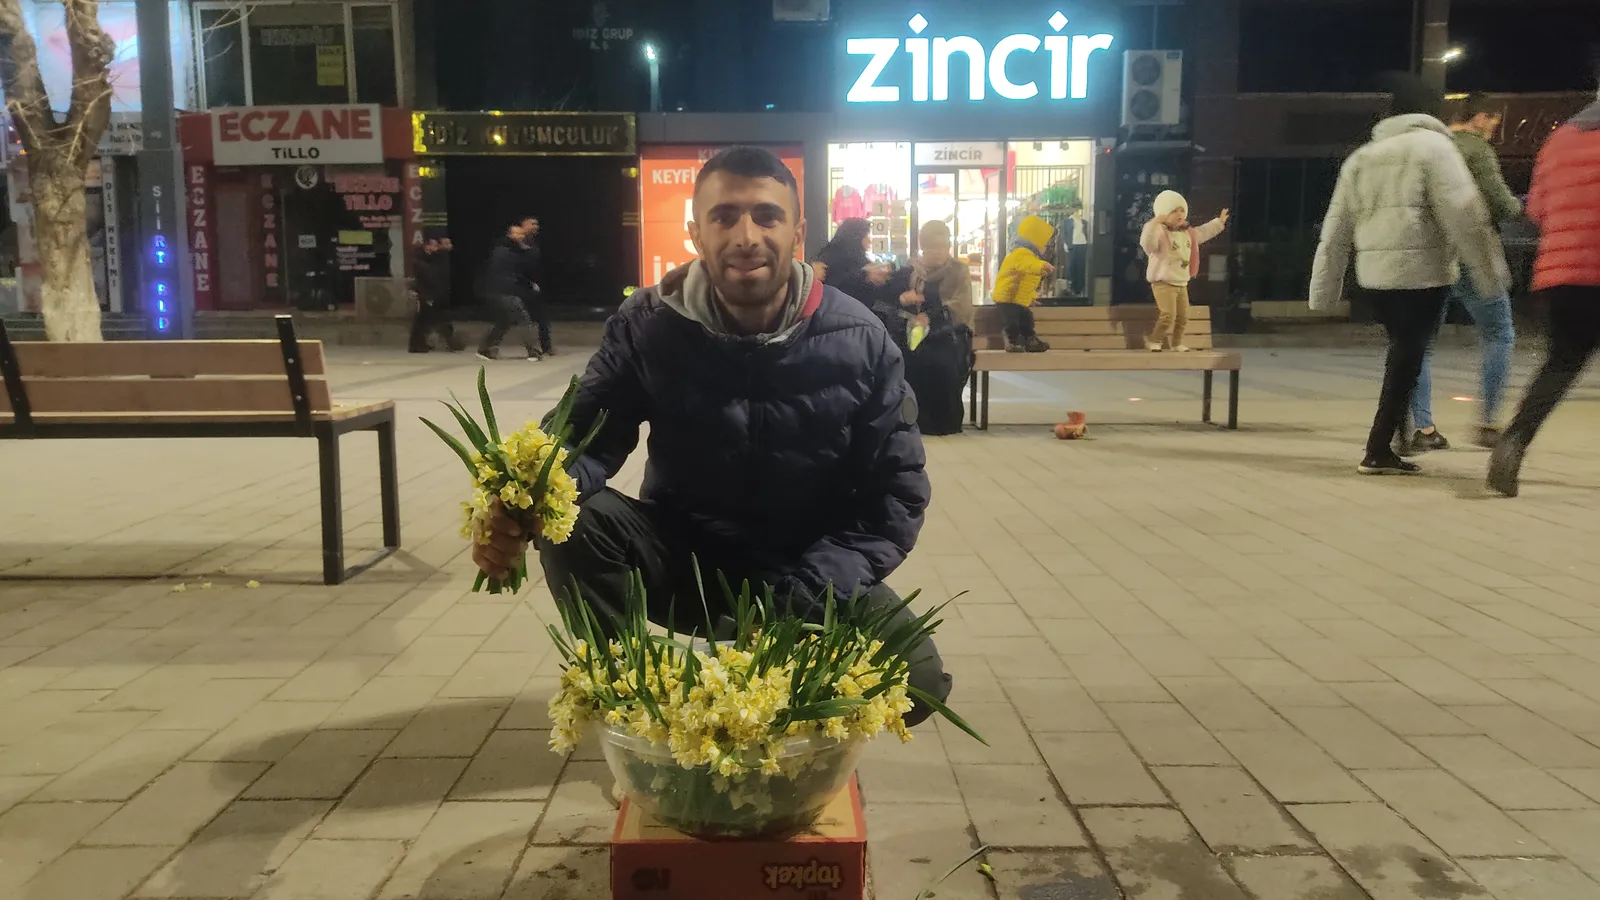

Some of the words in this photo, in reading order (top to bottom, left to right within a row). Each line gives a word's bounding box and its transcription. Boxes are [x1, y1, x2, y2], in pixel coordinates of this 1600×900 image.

[846, 11, 1114, 102] zincir
[218, 109, 373, 142] ECZANE
[652, 167, 697, 184] KEYFİ
[191, 165, 210, 292] ECZANE
[764, 860, 842, 889] topkek
